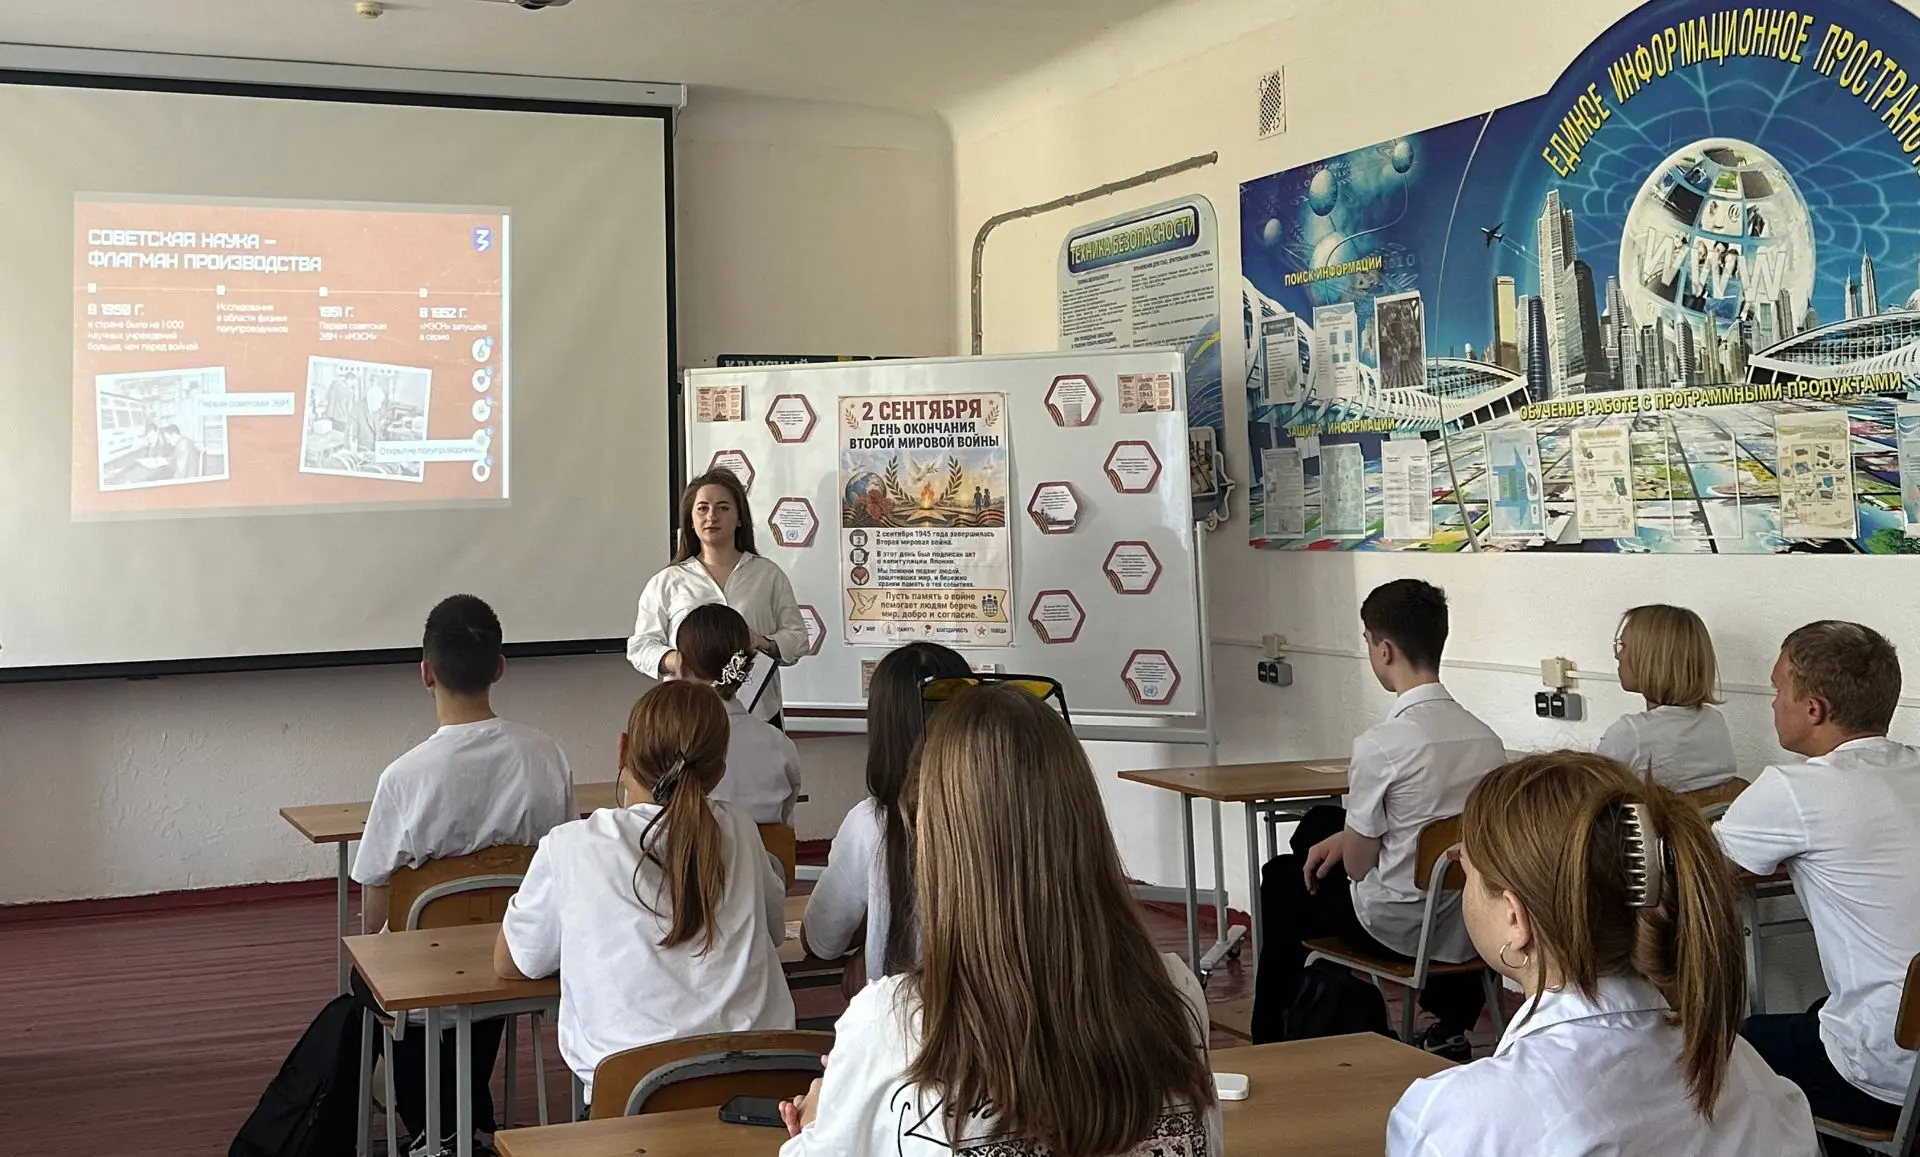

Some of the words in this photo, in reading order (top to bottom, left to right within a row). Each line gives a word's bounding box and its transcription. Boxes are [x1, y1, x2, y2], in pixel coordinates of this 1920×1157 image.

[1607, 7, 1815, 104] ИНФОРМАЦИОННОЕ
[1812, 23, 1920, 177] ПРОСТРАНС
[88, 229, 196, 247] СОВЕТСКАЯ
[201, 232, 259, 249] НАУКА
[1070, 238, 1110, 265] ТЕХНИКА
[1112, 215, 1196, 255] БЕЗОПАСНОСТИ
[88, 250, 178, 269] ФЛАГМАН
[184, 253, 322, 273] ПРОИЗВОДСТВА
[1284, 271, 1314, 286] ПОИСК
[1316, 255, 1383, 280] ИНФОРМАЦИИ
[419, 307, 428, 318] В
[431, 307, 457, 318] 1952
[319, 321, 348, 331] Первая
[1520, 400, 1586, 421] ОБУЧЕНИЕ
[1587, 394, 1639, 416] РАБОТЕ
[1642, 395, 1652, 411] С
[1655, 382, 1783, 410] ПРОГРАММНЫМИ
[1787, 372, 1903, 398] ПРОДУКТАМИ
[862, 402, 874, 421] 2
[879, 399, 982, 421] СЕНТЯБРЯ
[870, 423, 900, 436] ДЕНЬ
[904, 421, 976, 434] ОКОНЧАНИЯ
[1287, 423, 1324, 438] ЗАЩИТА
[1328, 417, 1396, 434] ИНФОРМАЦИИ
[850, 435, 895, 449] ВТОРОЙ
[898, 434, 955, 449] МИРОВОЙ
[957, 433, 999, 448] ВОЙНЫ
[880, 602, 918, 611] помогает
[920, 602, 948, 611] людям
[949, 600, 977, 611] беречь
[885, 592, 910, 601] Пусть
[912, 592, 942, 600] память
[950, 590, 976, 600] войне
[882, 612, 900, 620] мир,
[902, 611, 927, 620] добро
[937, 611, 977, 619] согласие.
